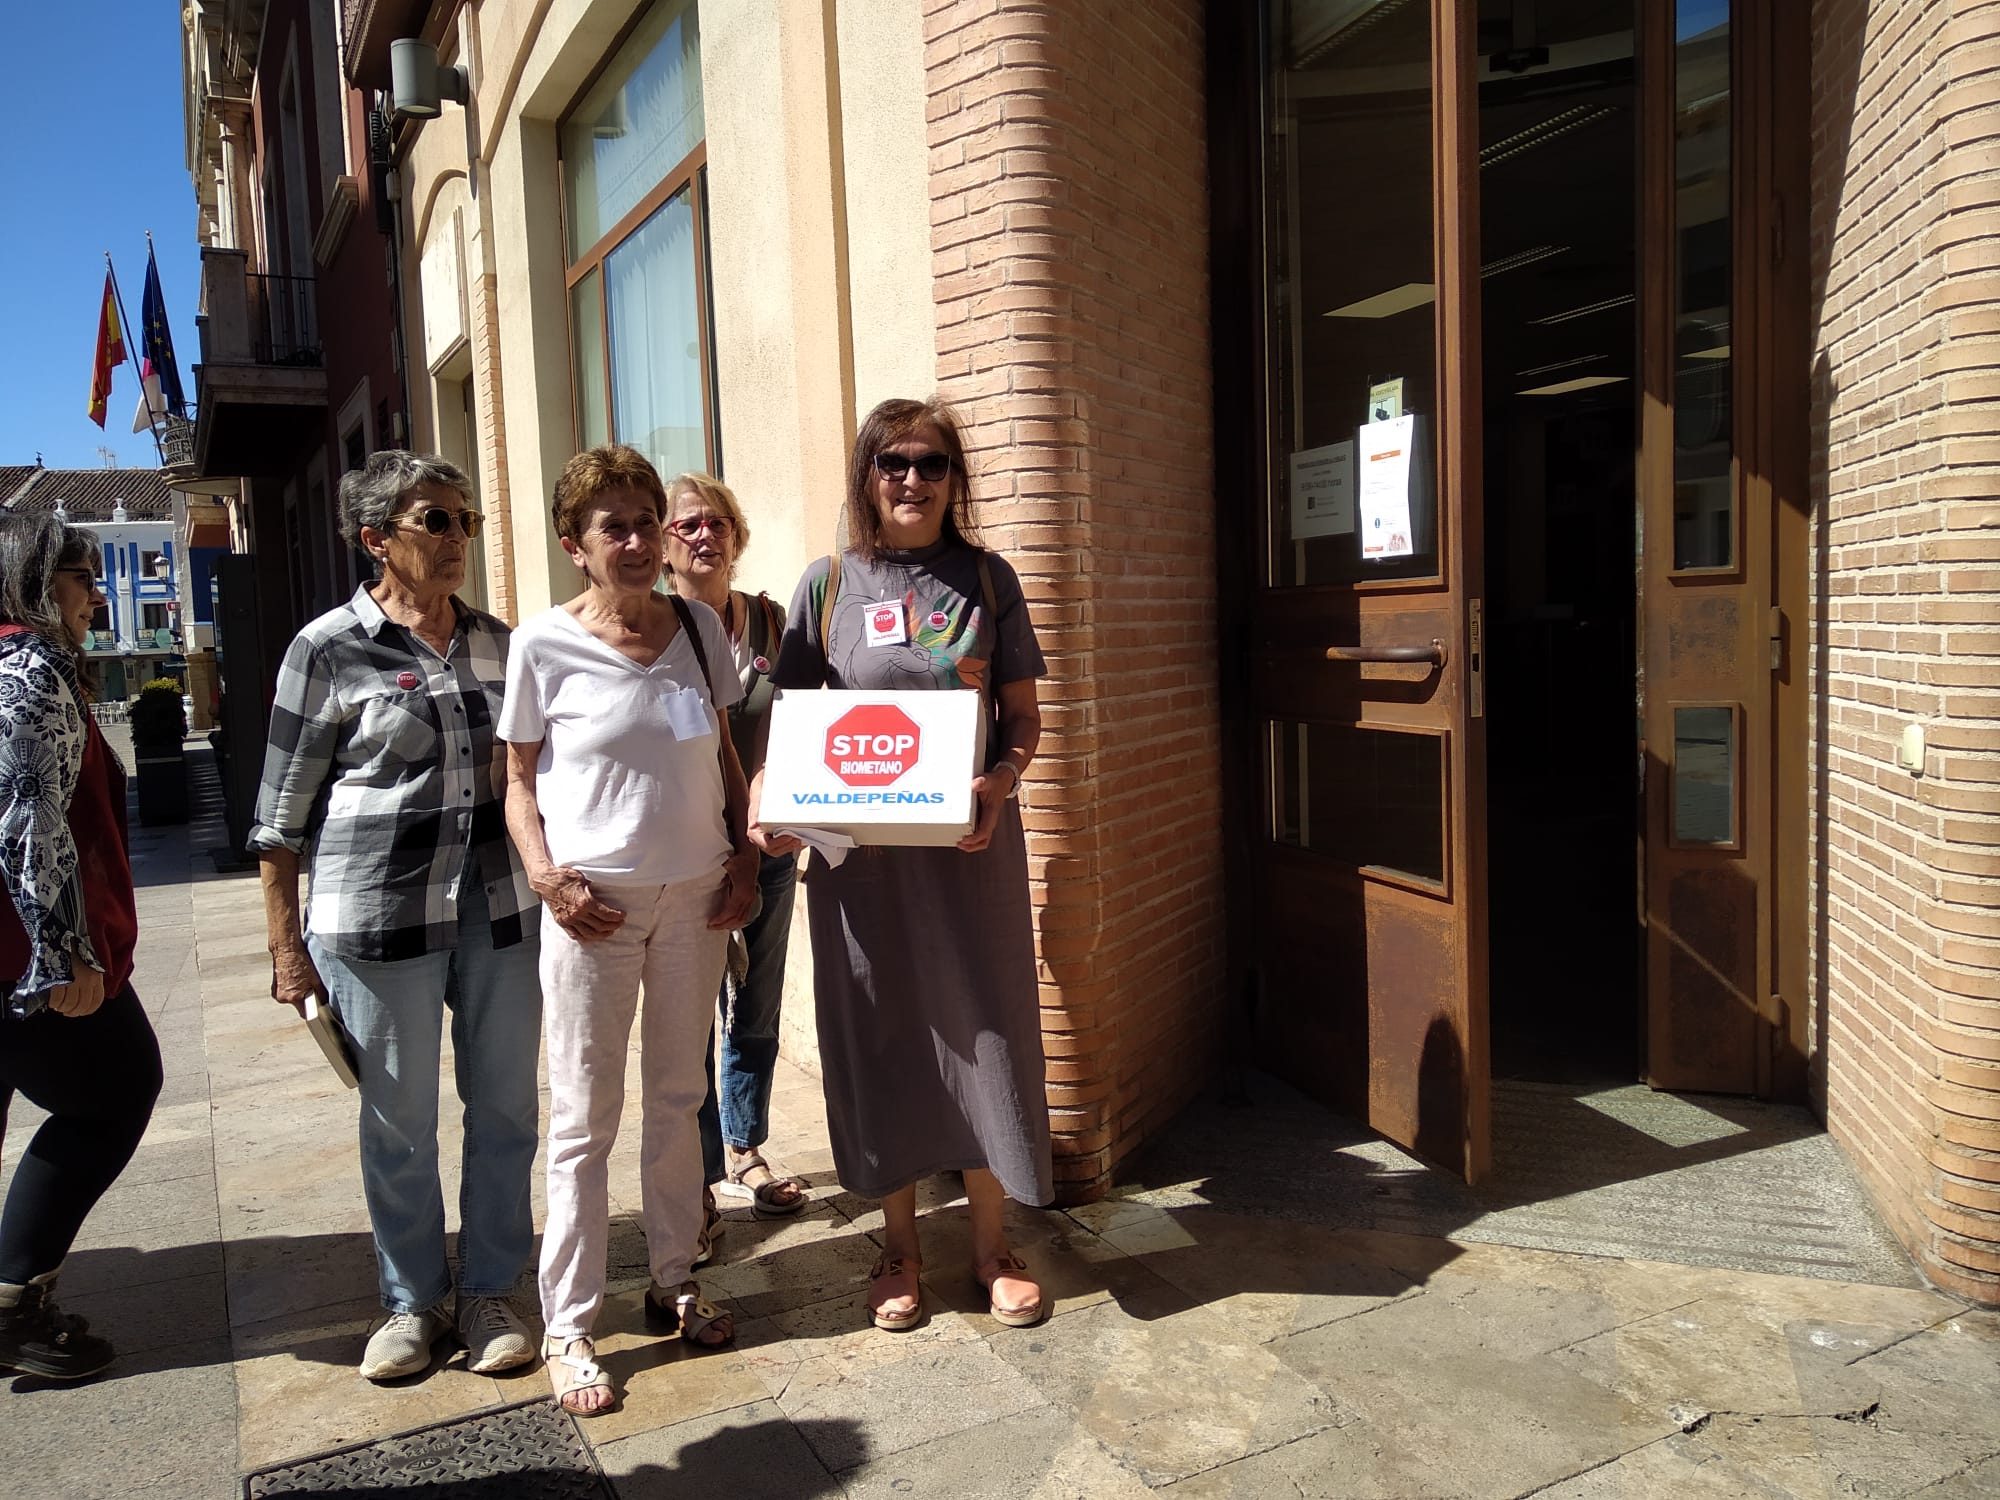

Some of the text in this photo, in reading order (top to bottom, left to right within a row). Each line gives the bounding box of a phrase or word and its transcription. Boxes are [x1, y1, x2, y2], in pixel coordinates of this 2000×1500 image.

[875, 612, 894, 622] STOP
[831, 734, 915, 756] STOP
[840, 760, 903, 775] BIOMETANO
[792, 790, 945, 805] VALDEPEÑAS
